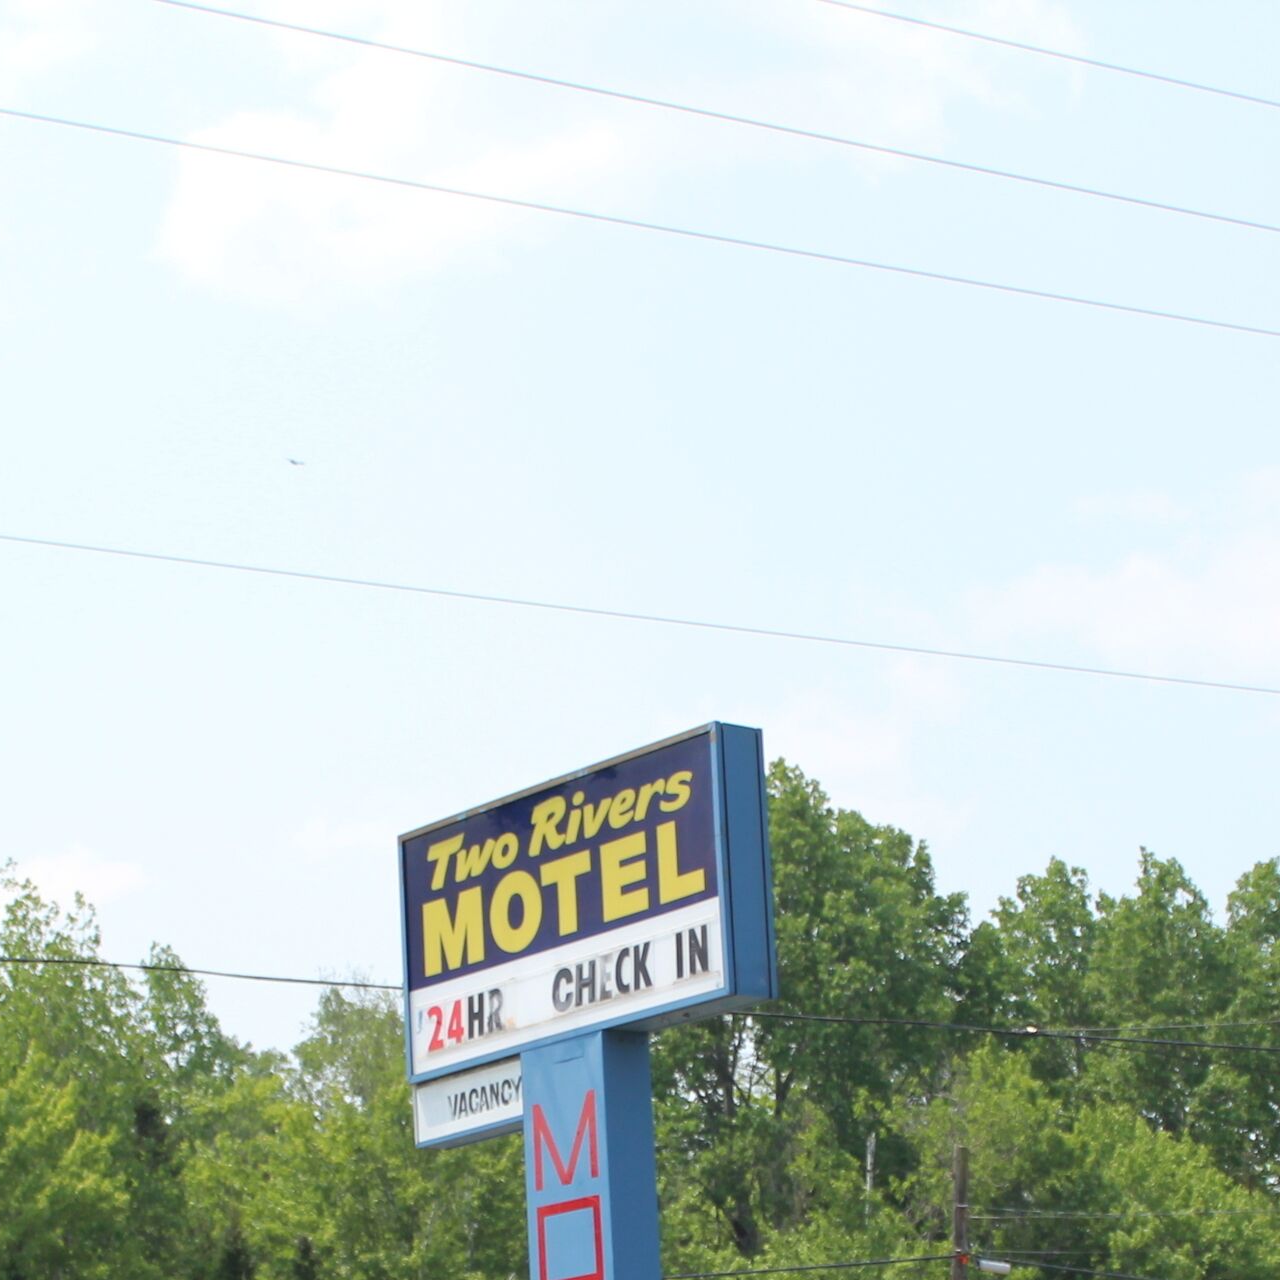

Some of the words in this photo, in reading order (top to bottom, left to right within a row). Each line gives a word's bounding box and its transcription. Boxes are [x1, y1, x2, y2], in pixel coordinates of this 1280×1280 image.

[427, 832, 519, 891] Two
[528, 771, 693, 857] Rivers
[422, 820, 705, 978] MOTEL
[552, 942, 652, 1013] CHECK
[675, 924, 708, 979] IN
[448, 1075, 522, 1120] VACANCY
